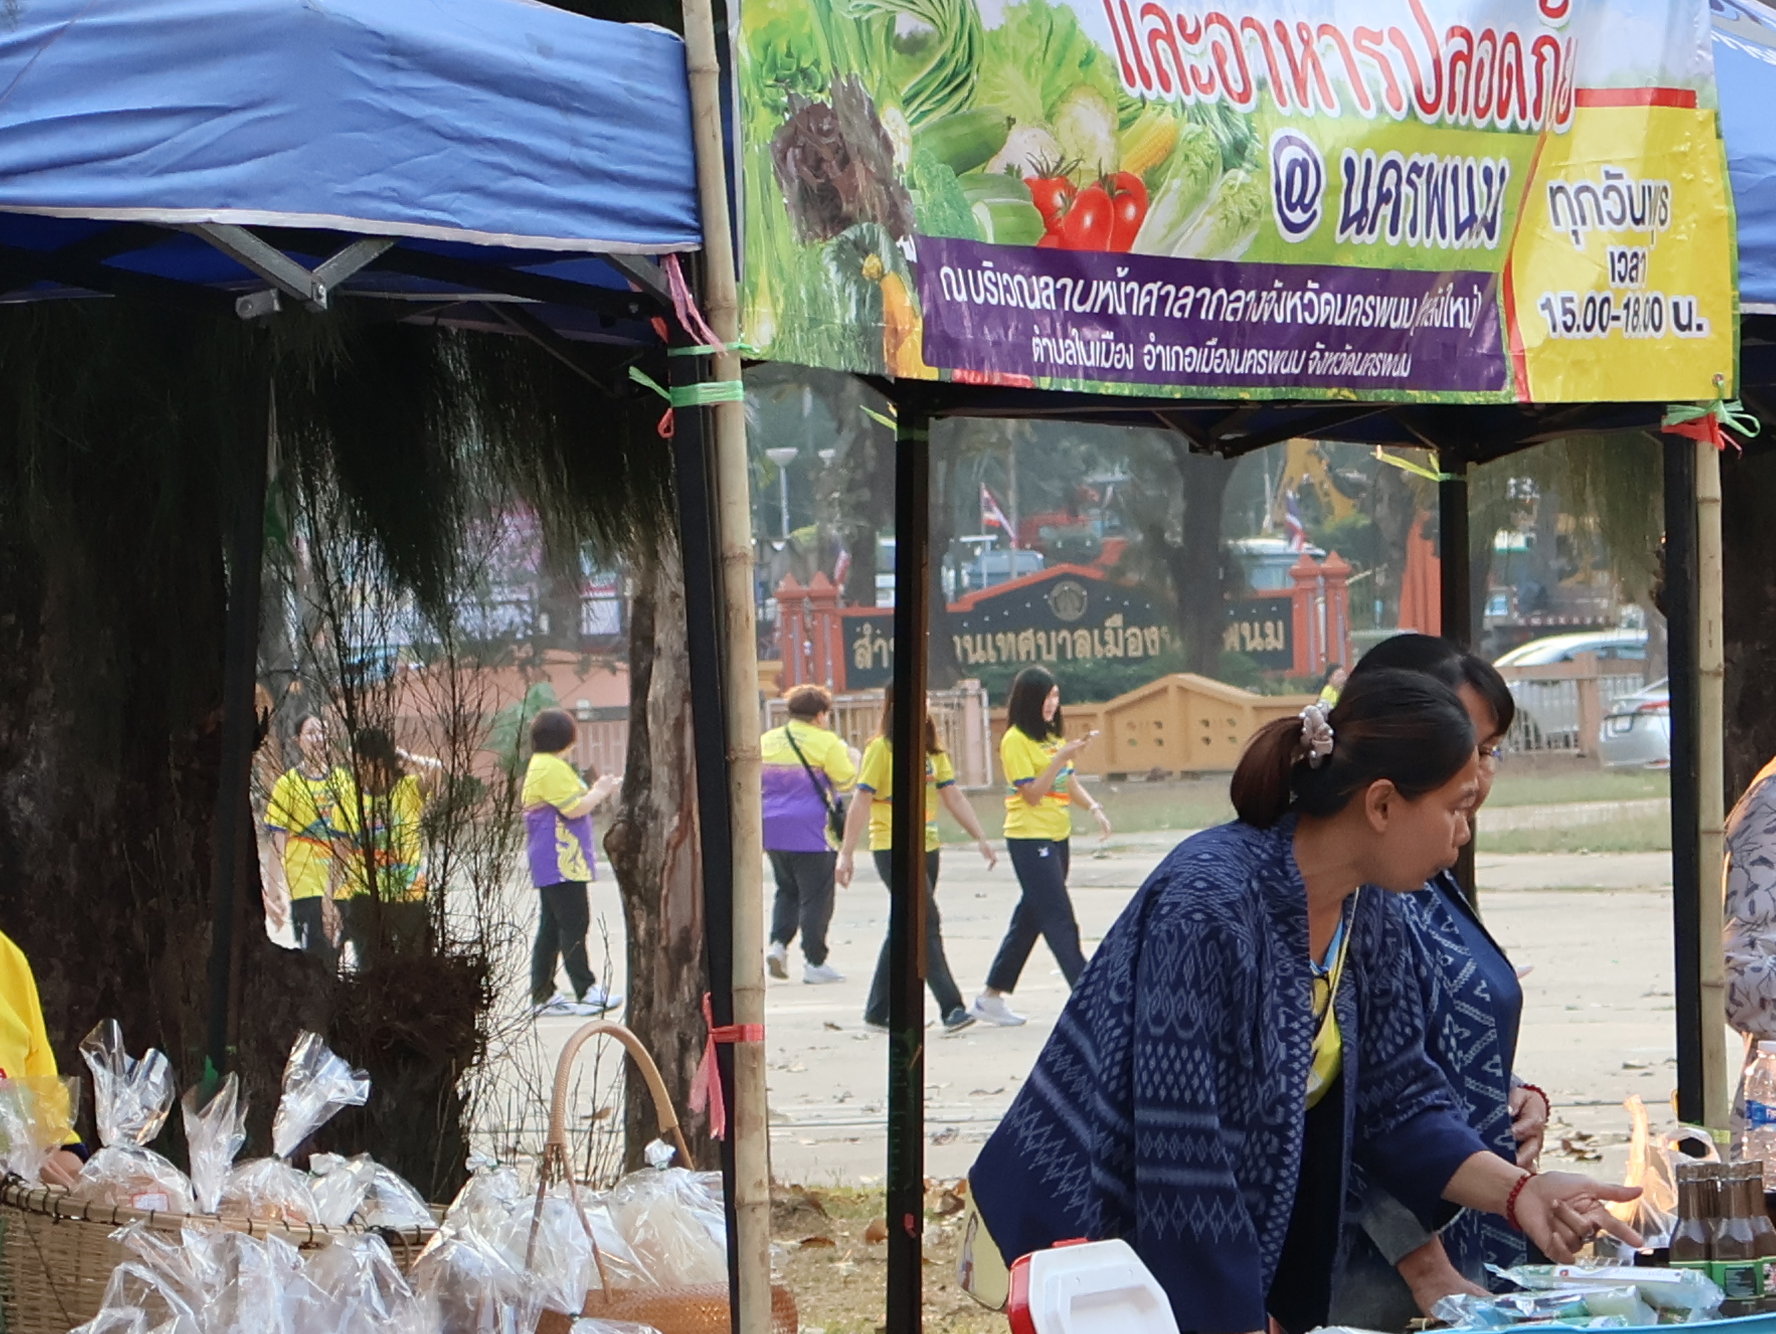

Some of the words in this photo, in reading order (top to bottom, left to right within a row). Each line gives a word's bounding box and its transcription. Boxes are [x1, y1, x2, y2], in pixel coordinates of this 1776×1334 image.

[1272, 133, 1324, 233] @
[1340, 154, 1507, 243] นครพนม
[1608, 249, 1647, 285] เวลา
